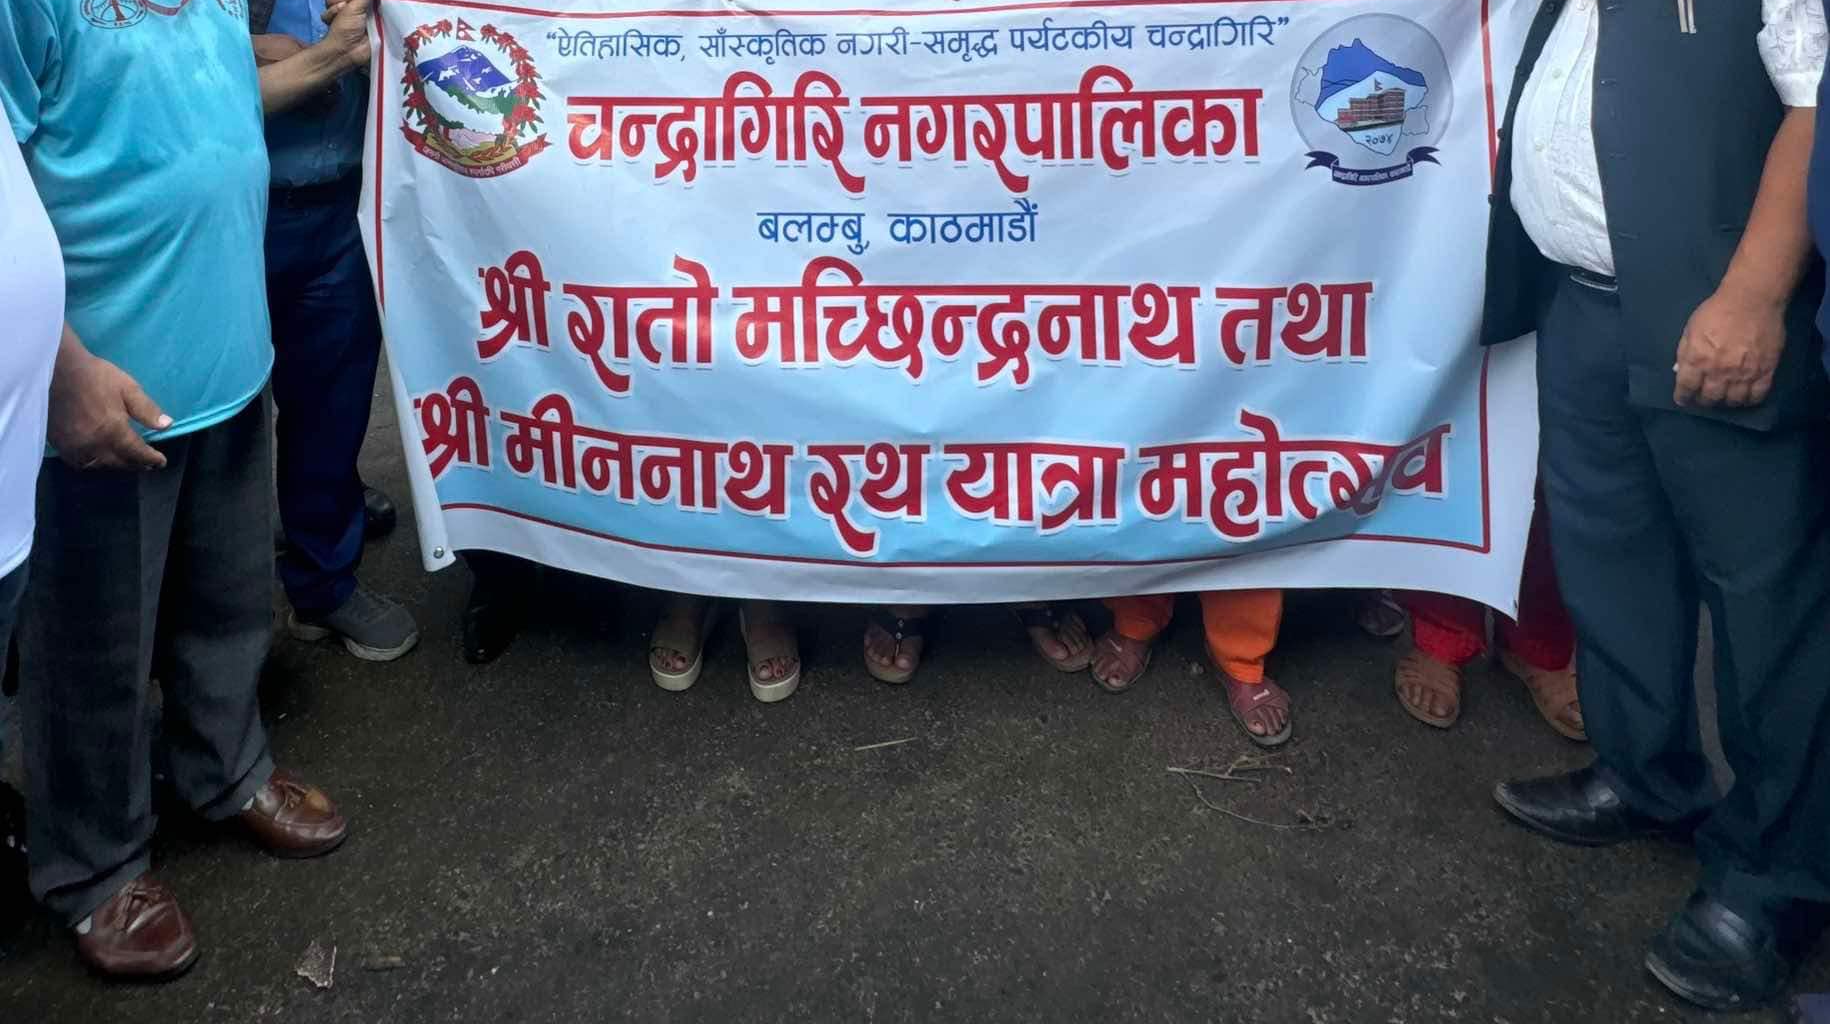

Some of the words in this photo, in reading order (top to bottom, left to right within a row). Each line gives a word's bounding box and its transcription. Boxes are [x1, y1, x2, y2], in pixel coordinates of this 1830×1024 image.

[699, 29, 826, 66] साँस्कृतिक
[836, 28, 999, 63] नगरी-समृद्ध
[1009, 18, 1136, 53] पर्यटकीय
[568, 71, 865, 192] चन्द्रागिरि
[862, 65, 1264, 193] नगरपालिका
[886, 198, 1039, 244] काठमाडौं
[477, 250, 551, 359] श्री
[563, 256, 719, 392] रातो
[733, 256, 1201, 385] मच्छिन्द्रनाथ
[1215, 282, 1373, 364] तथा
[412, 376, 491, 479] श्री
[500, 394, 794, 517] मीननाथ
[807, 442, 931, 553] रथ
[943, 442, 1126, 531] यात्रा
